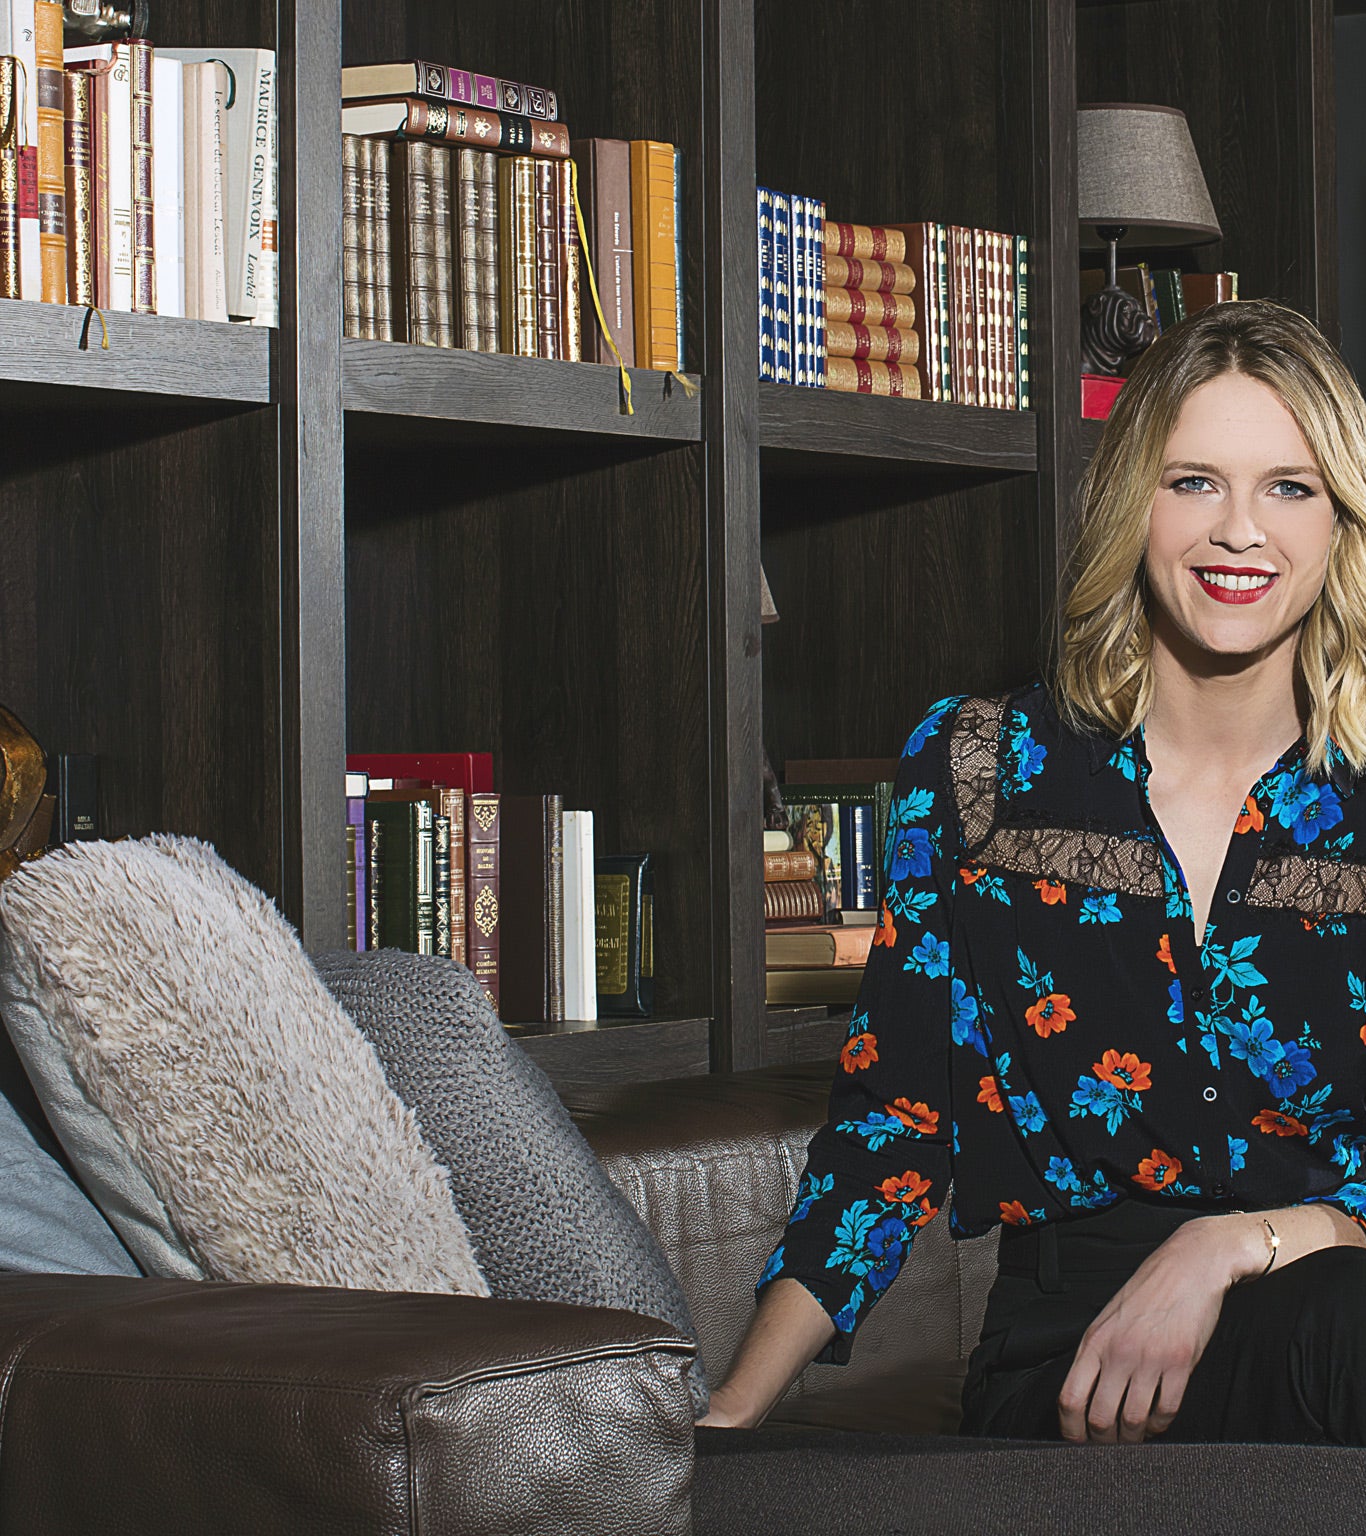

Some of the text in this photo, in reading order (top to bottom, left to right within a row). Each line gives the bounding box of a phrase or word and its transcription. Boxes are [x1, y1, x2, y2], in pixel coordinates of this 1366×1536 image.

[215, 91, 223, 105] Le
[215, 149, 222, 163] du
[245, 69, 271, 299] MAURICE GENEVOIX Lorelei
